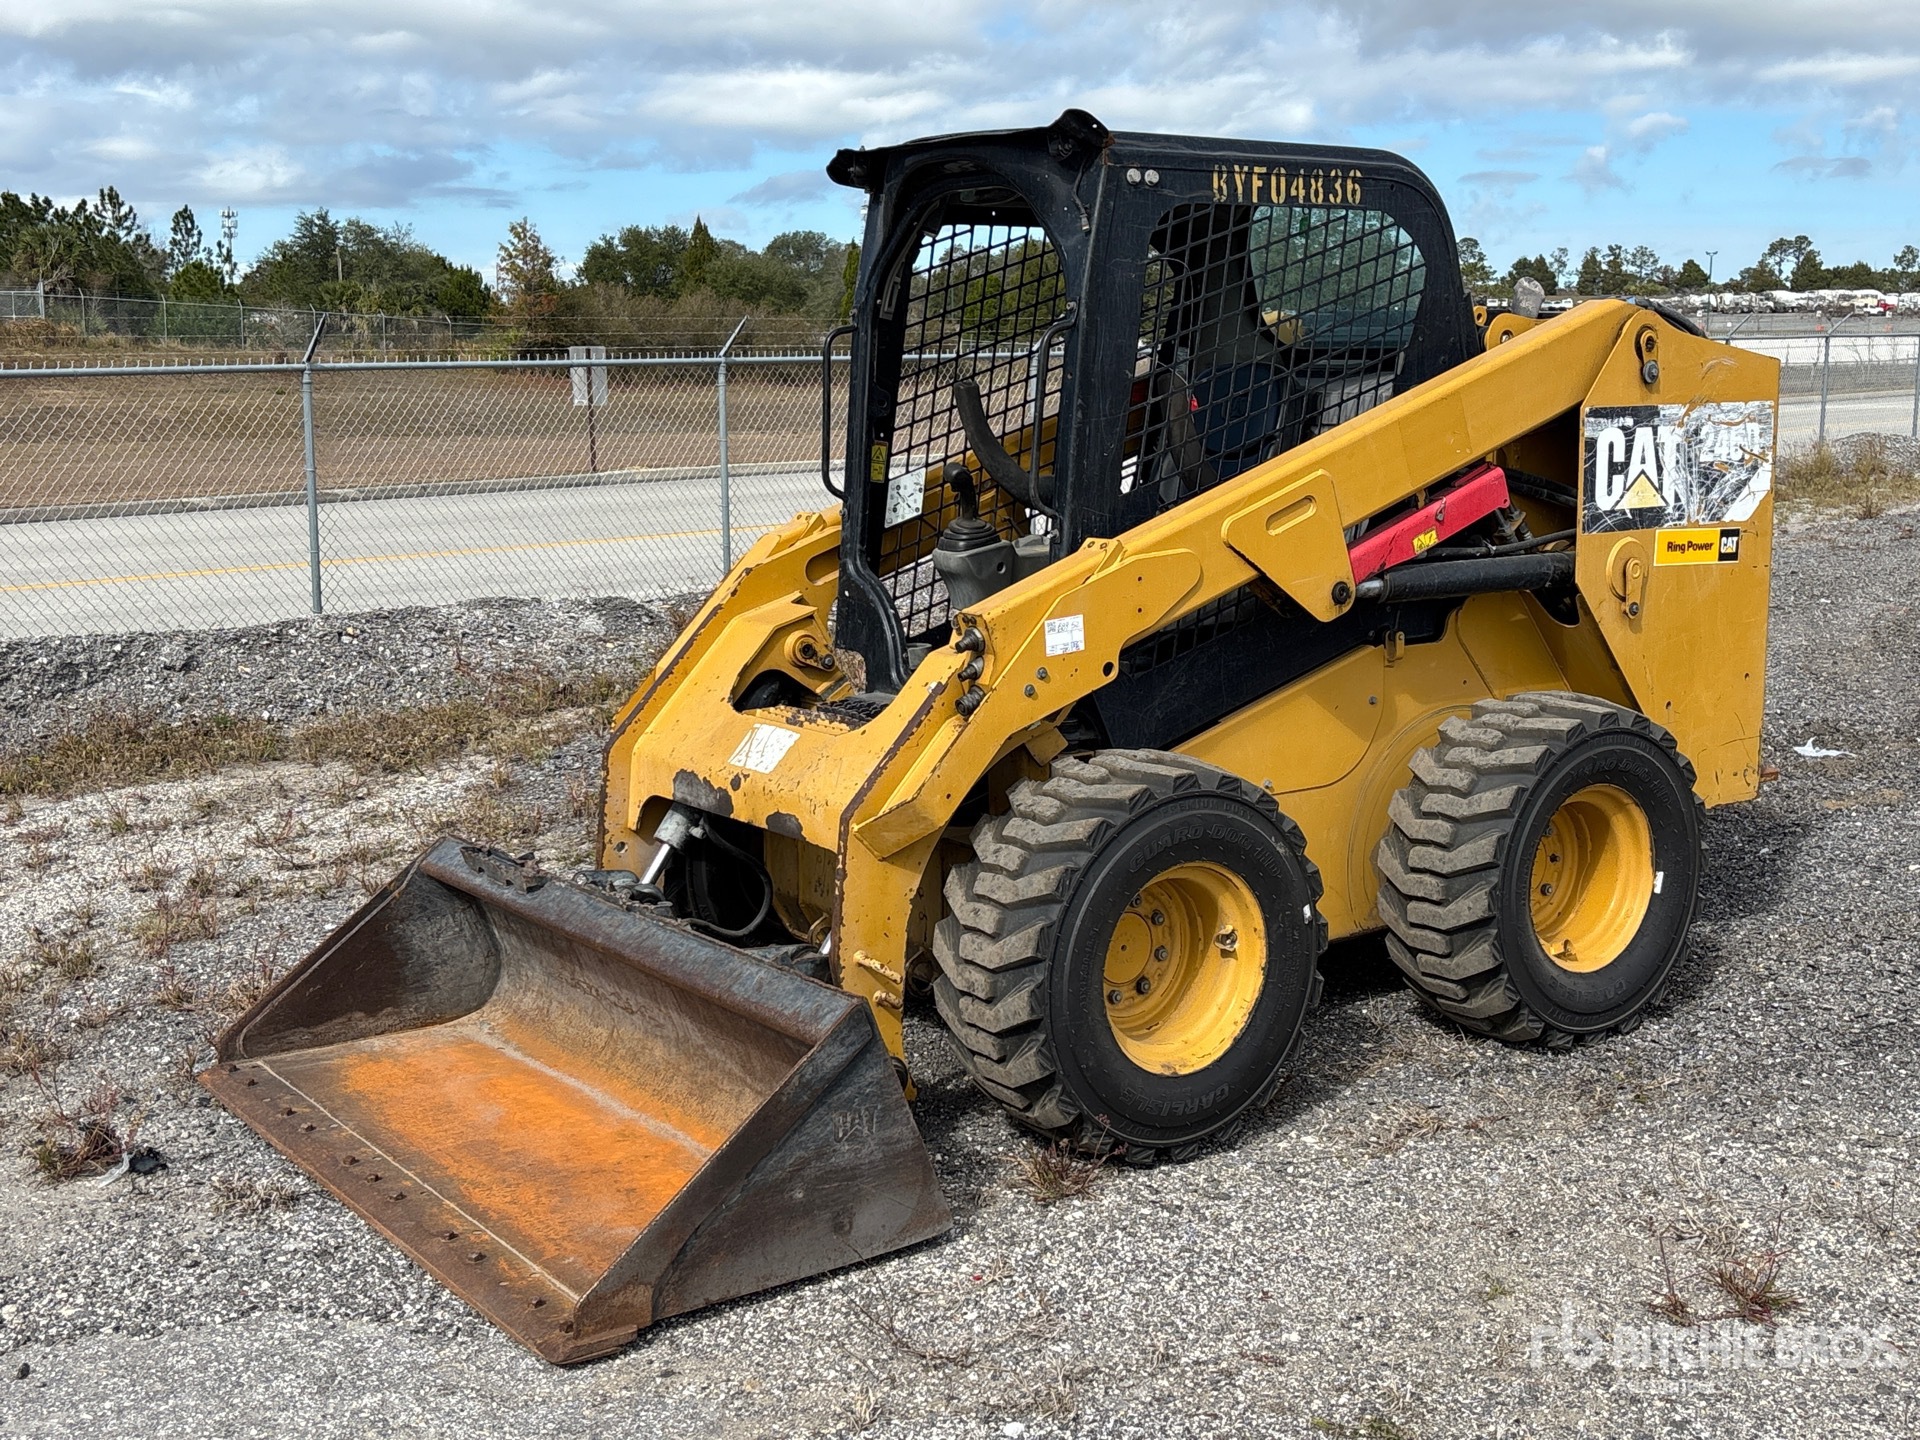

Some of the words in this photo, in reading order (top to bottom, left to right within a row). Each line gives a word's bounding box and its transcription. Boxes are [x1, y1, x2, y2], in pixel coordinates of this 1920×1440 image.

[1212, 164, 1364, 206] BYF04836
[1667, 541, 1686, 554] Ring
[1687, 540, 1715, 552] Power
[1720, 536, 1738, 554] CAT
